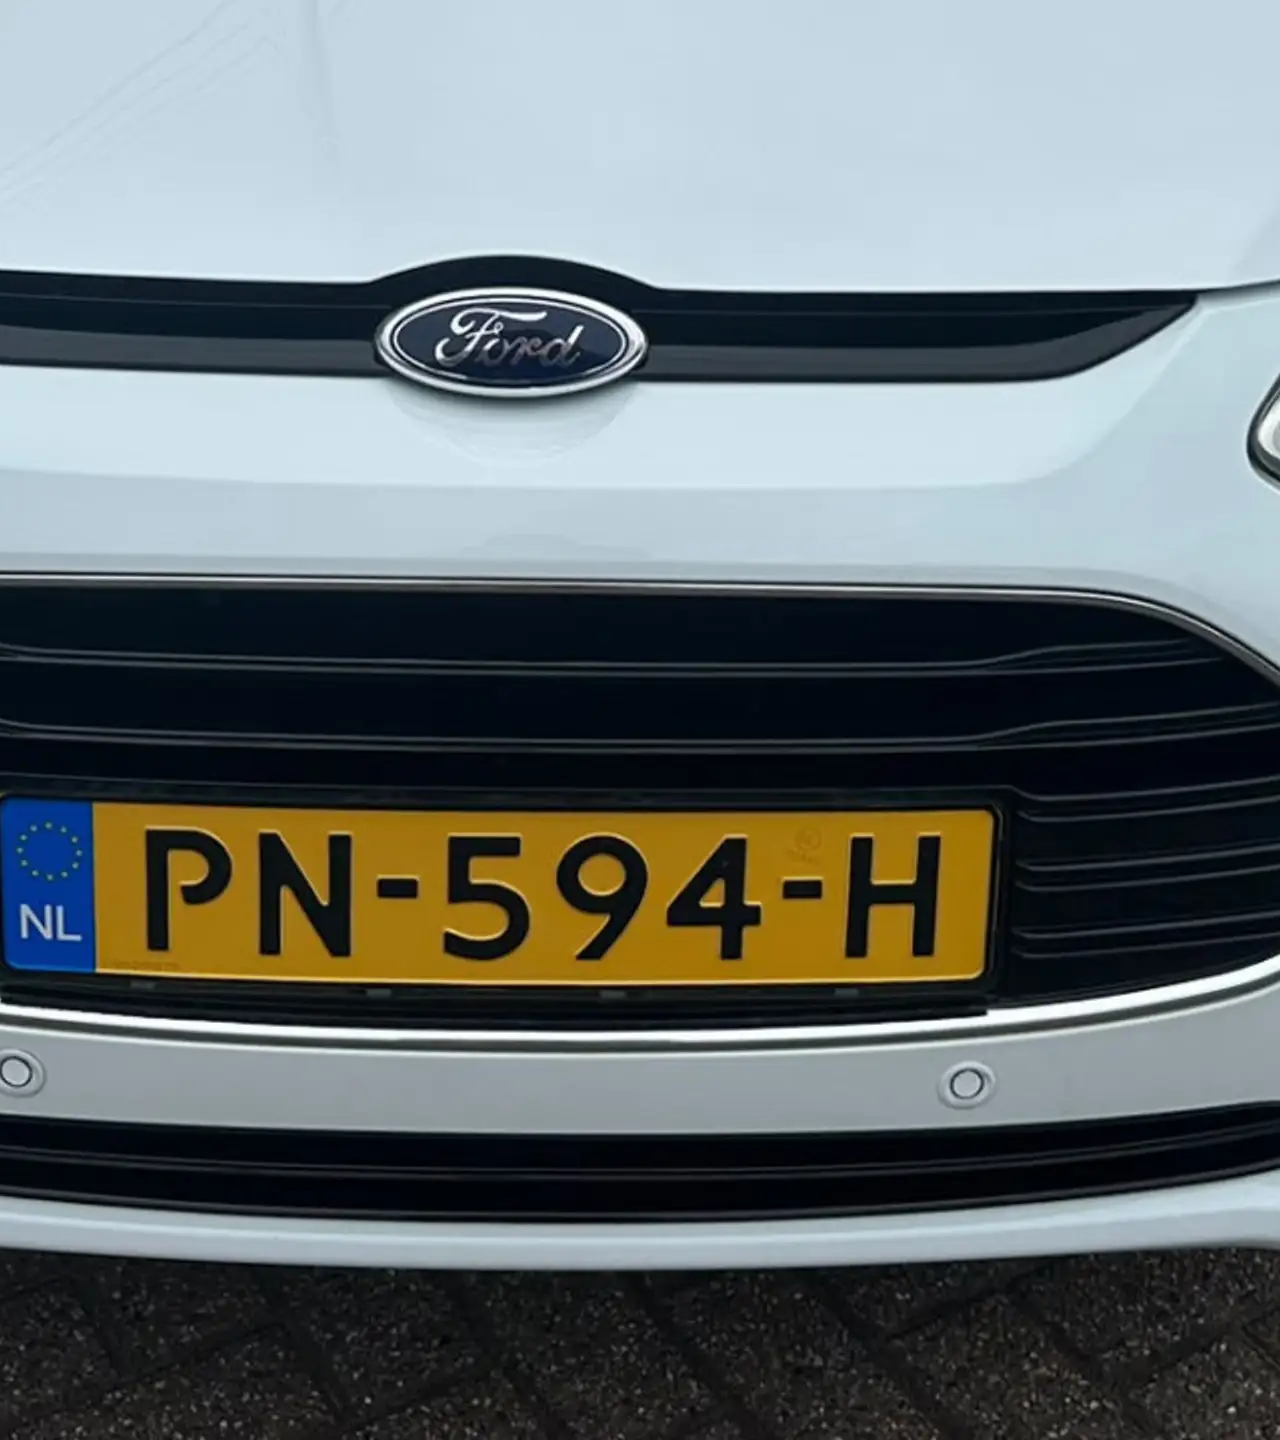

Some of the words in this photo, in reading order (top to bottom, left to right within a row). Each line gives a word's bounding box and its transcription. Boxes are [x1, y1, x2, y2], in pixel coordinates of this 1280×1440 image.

[434, 308, 585, 367] Ford
[19, 903, 82, 943] NL
[144, 826, 942, 961] PN-594-H
